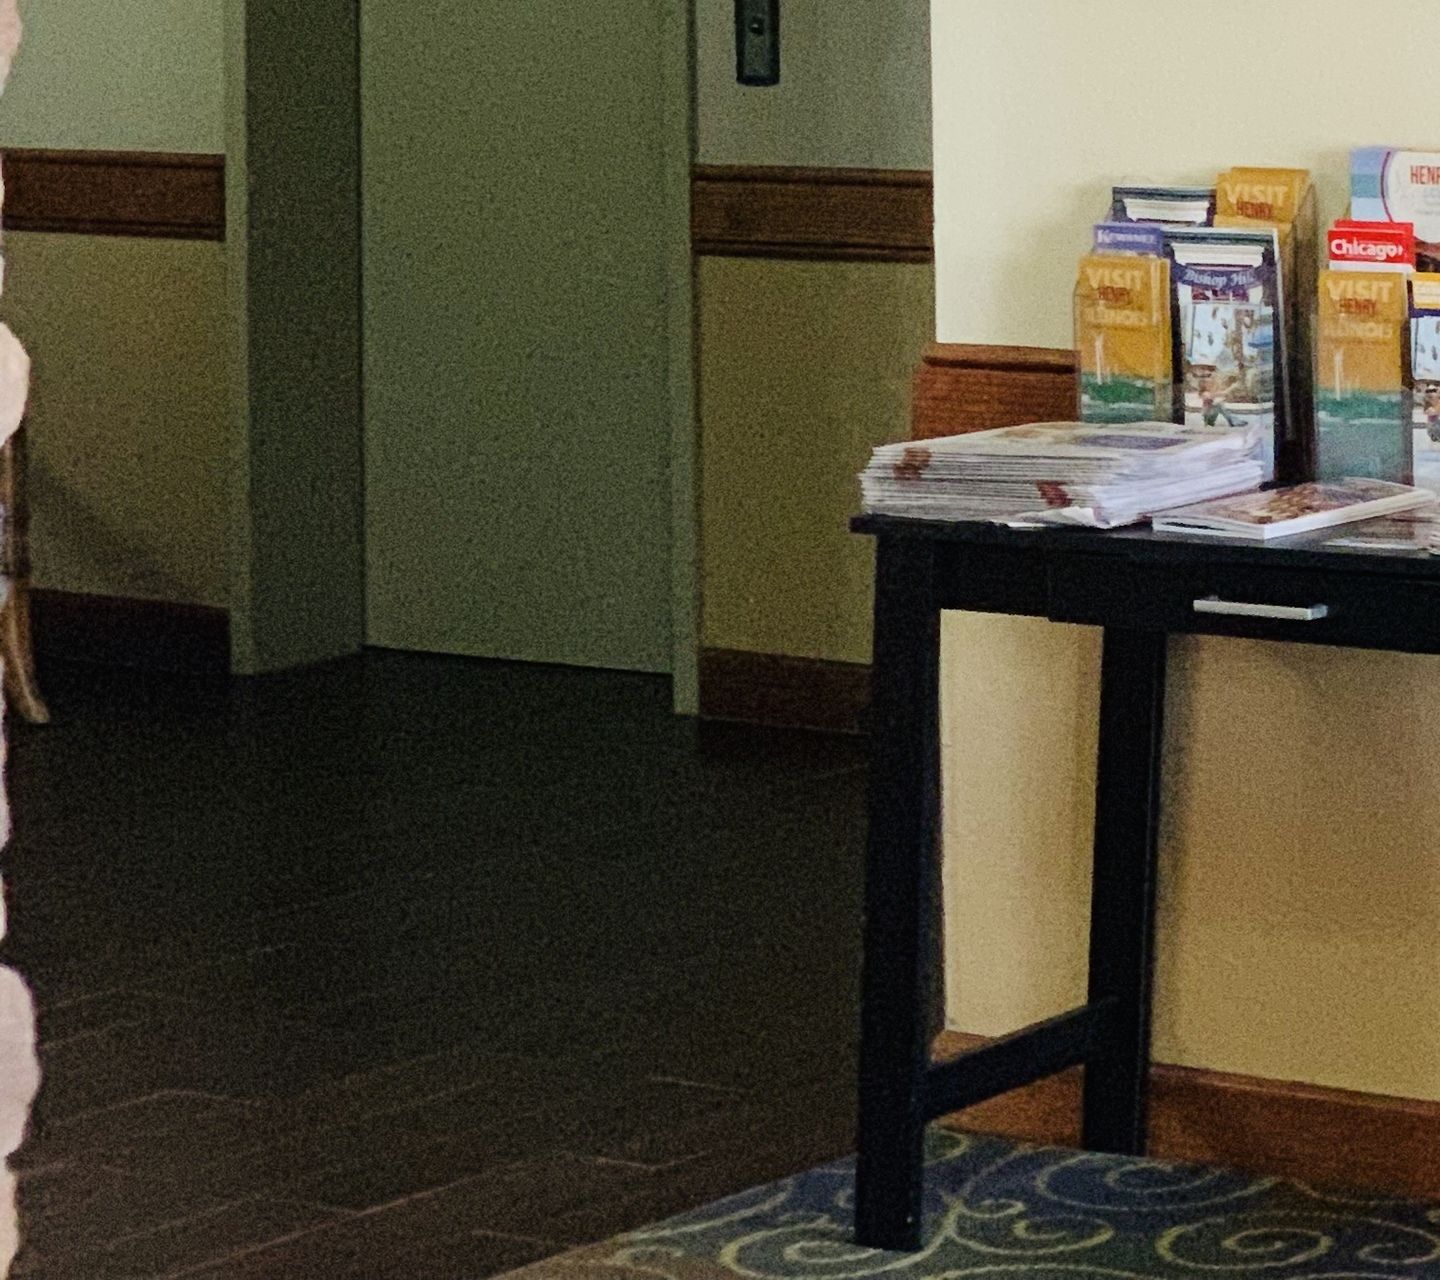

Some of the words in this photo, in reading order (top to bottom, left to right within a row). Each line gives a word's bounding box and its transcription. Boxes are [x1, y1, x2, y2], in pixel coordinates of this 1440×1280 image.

[1224, 182, 1291, 208] VISIT
[1330, 236, 1399, 261] Chicago
[1085, 268, 1144, 291] VISIT
[1325, 279, 1394, 304] VISIT
